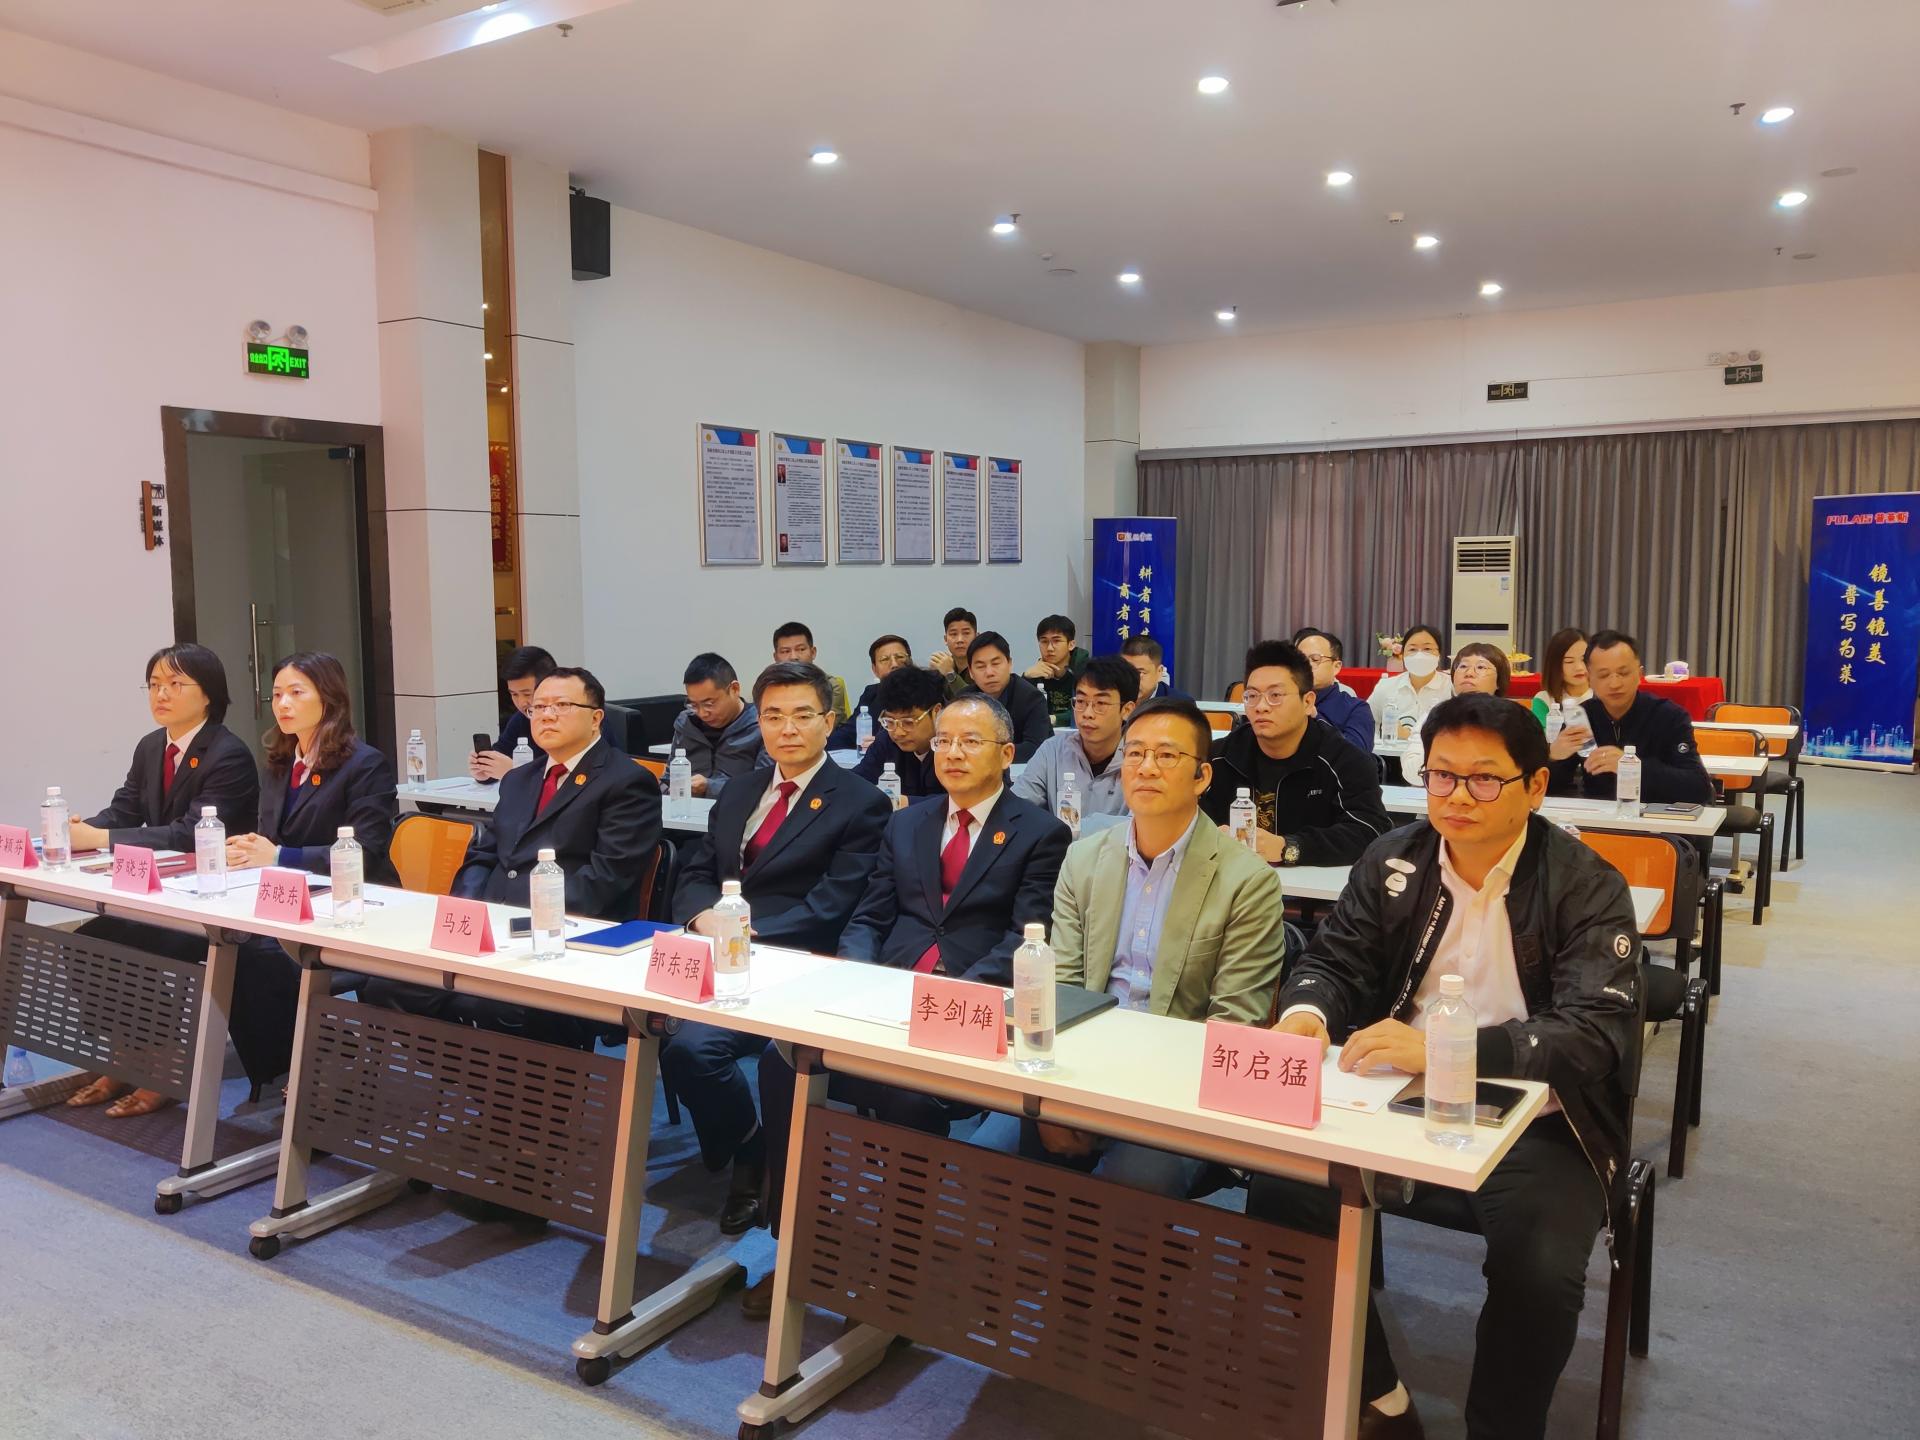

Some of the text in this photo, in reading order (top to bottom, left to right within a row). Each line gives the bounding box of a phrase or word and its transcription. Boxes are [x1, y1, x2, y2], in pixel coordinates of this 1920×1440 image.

[289, 356, 306, 369] EXIT
[259, 882, 298, 905] 苏晓东
[442, 912, 472, 936] 马龙
[651, 948, 700, 980] 邹东强
[917, 993, 994, 1030] 李剑雄
[1211, 1043, 1309, 1087] 邹启猛
